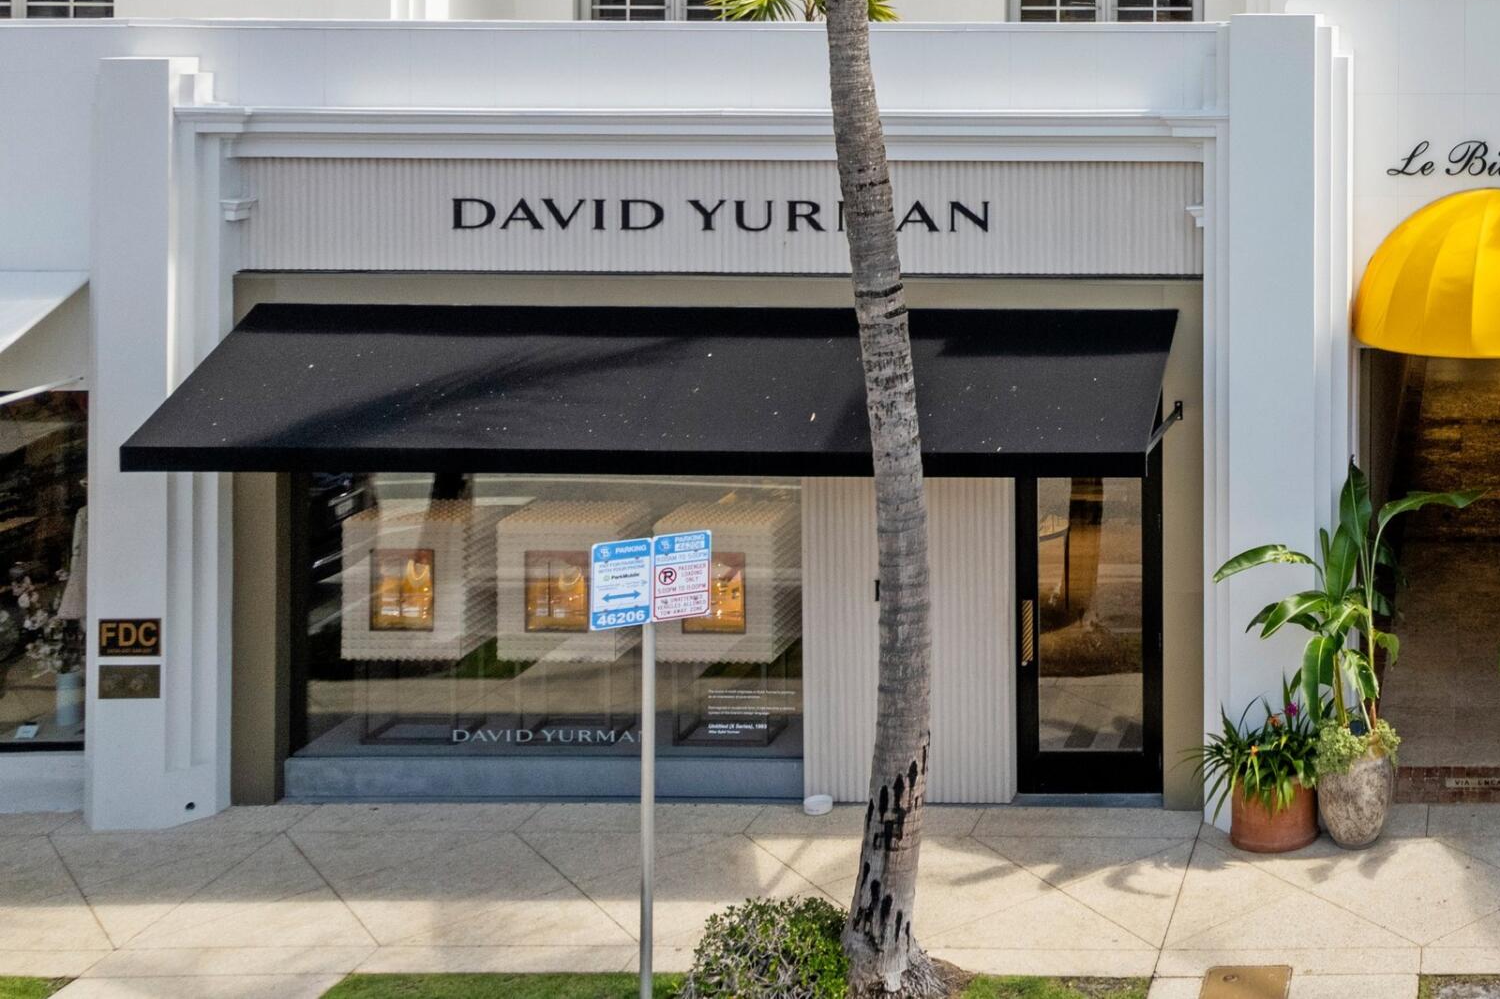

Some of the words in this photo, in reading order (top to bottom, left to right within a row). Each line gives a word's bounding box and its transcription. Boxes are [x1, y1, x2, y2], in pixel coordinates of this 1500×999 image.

[1386, 140, 1436, 176] Le
[452, 197, 665, 231] DAVID
[687, 198, 991, 233] YURAN
[615, 544, 647, 553] PARKING
[596, 610, 646, 626] 46206
[101, 622, 157, 647] FDC
[452, 729, 533, 743] DAVID
[544, 729, 643, 743] YURMA
